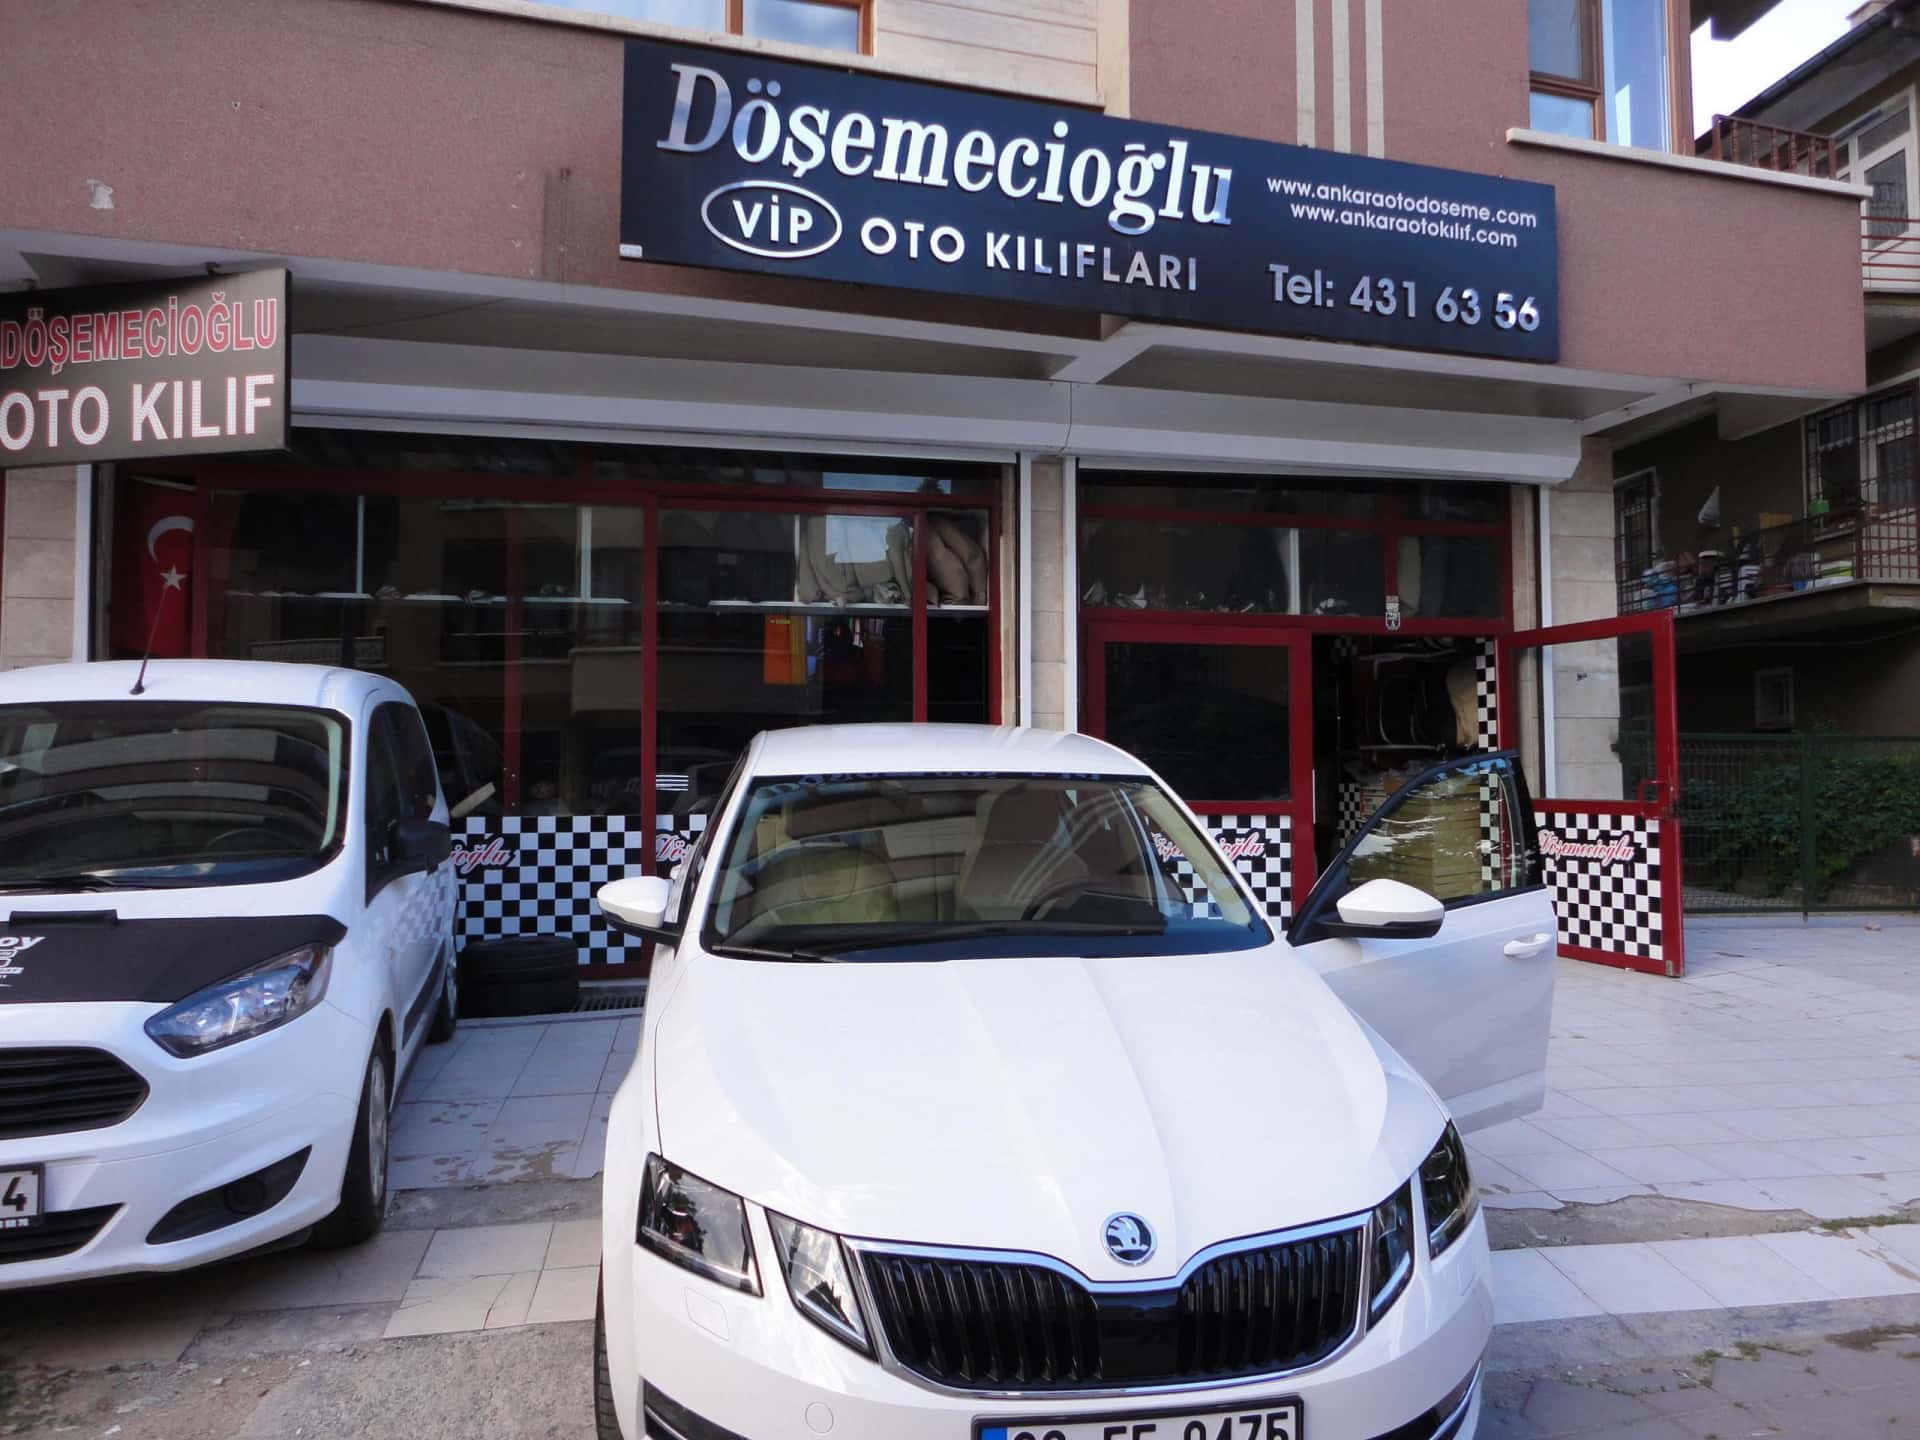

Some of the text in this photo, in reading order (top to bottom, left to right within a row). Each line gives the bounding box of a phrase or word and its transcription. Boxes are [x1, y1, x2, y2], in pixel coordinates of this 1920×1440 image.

[656, 63, 1232, 236] Döşemecioğlu
[1266, 176, 1538, 229] www.ankaraotodoseme.com
[861, 217, 966, 264] OTO
[986, 231, 1198, 292] KILIFLARI
[0, 292, 278, 376] DÖŞEMECİOĞLU
[1268, 263, 1541, 332] Tel: 431 63 56
[0, 374, 275, 451] OTO KILIF
